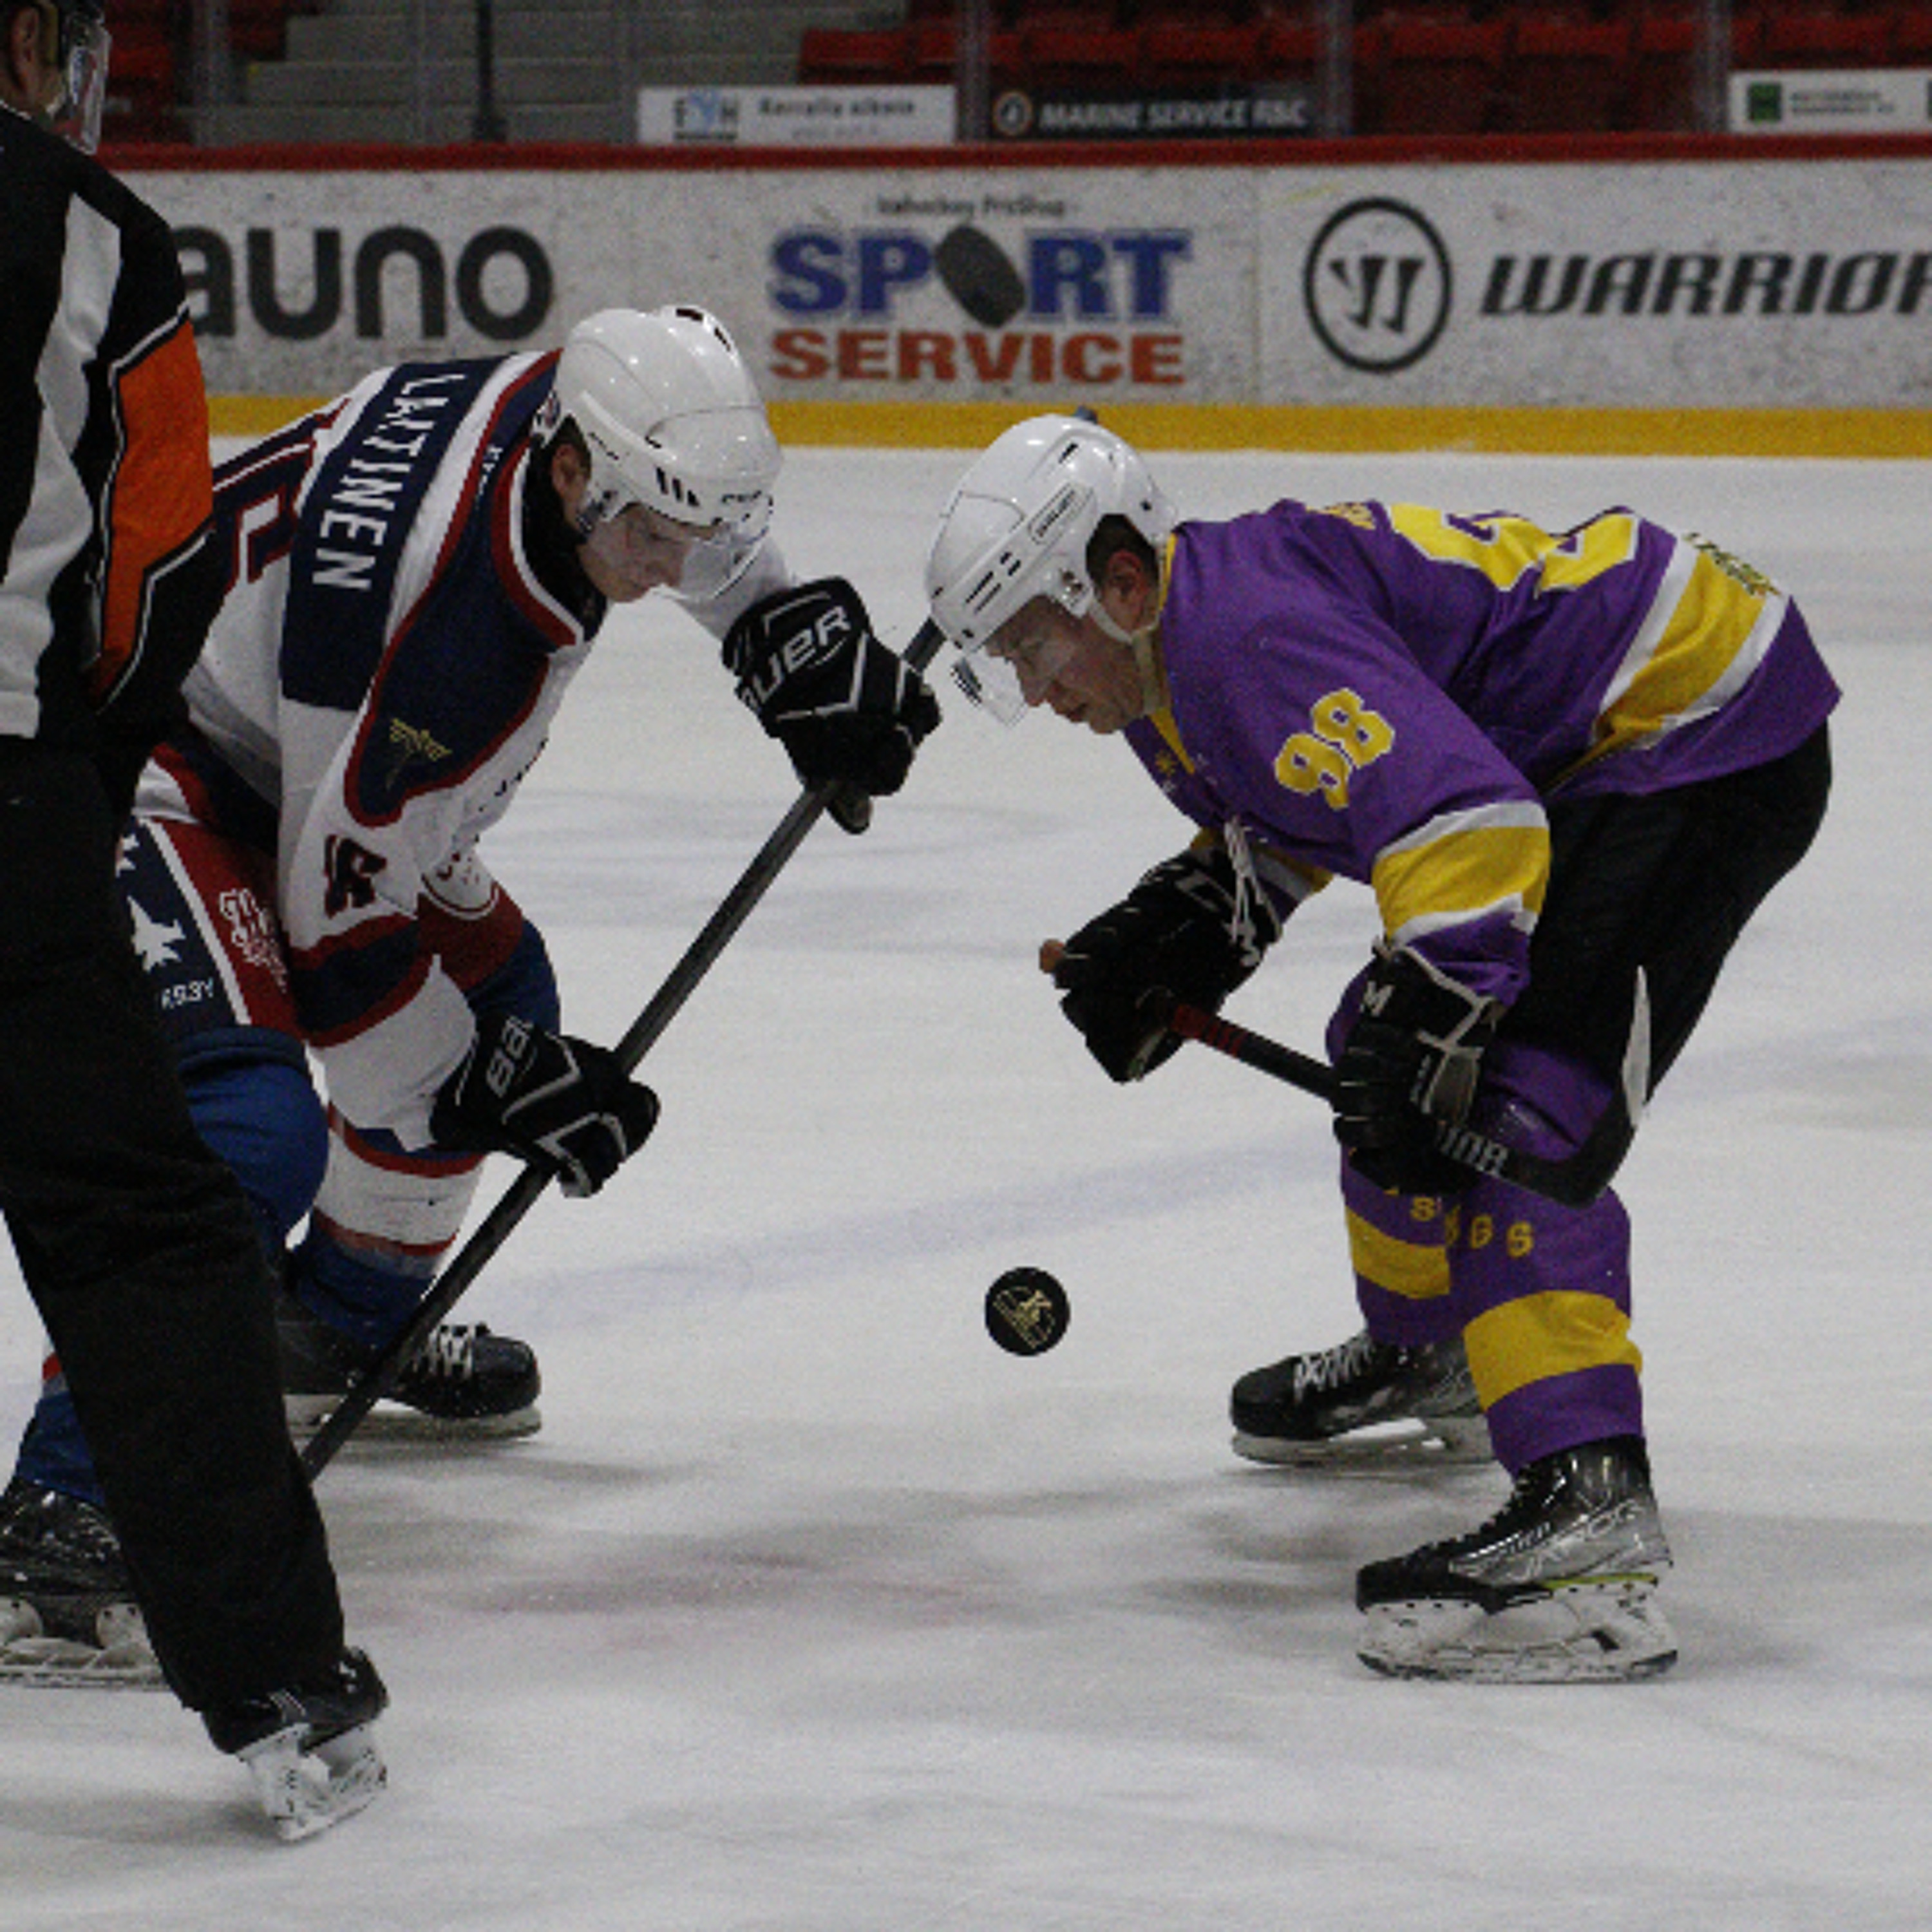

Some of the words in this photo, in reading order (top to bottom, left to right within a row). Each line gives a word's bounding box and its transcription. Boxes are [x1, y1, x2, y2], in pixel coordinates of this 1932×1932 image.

[1038, 102, 1144, 128] MARINE
[1147, 100, 1248, 127] SERVICE
[770, 327, 1185, 384] SERVICE
[1274, 687, 1396, 810] 98
